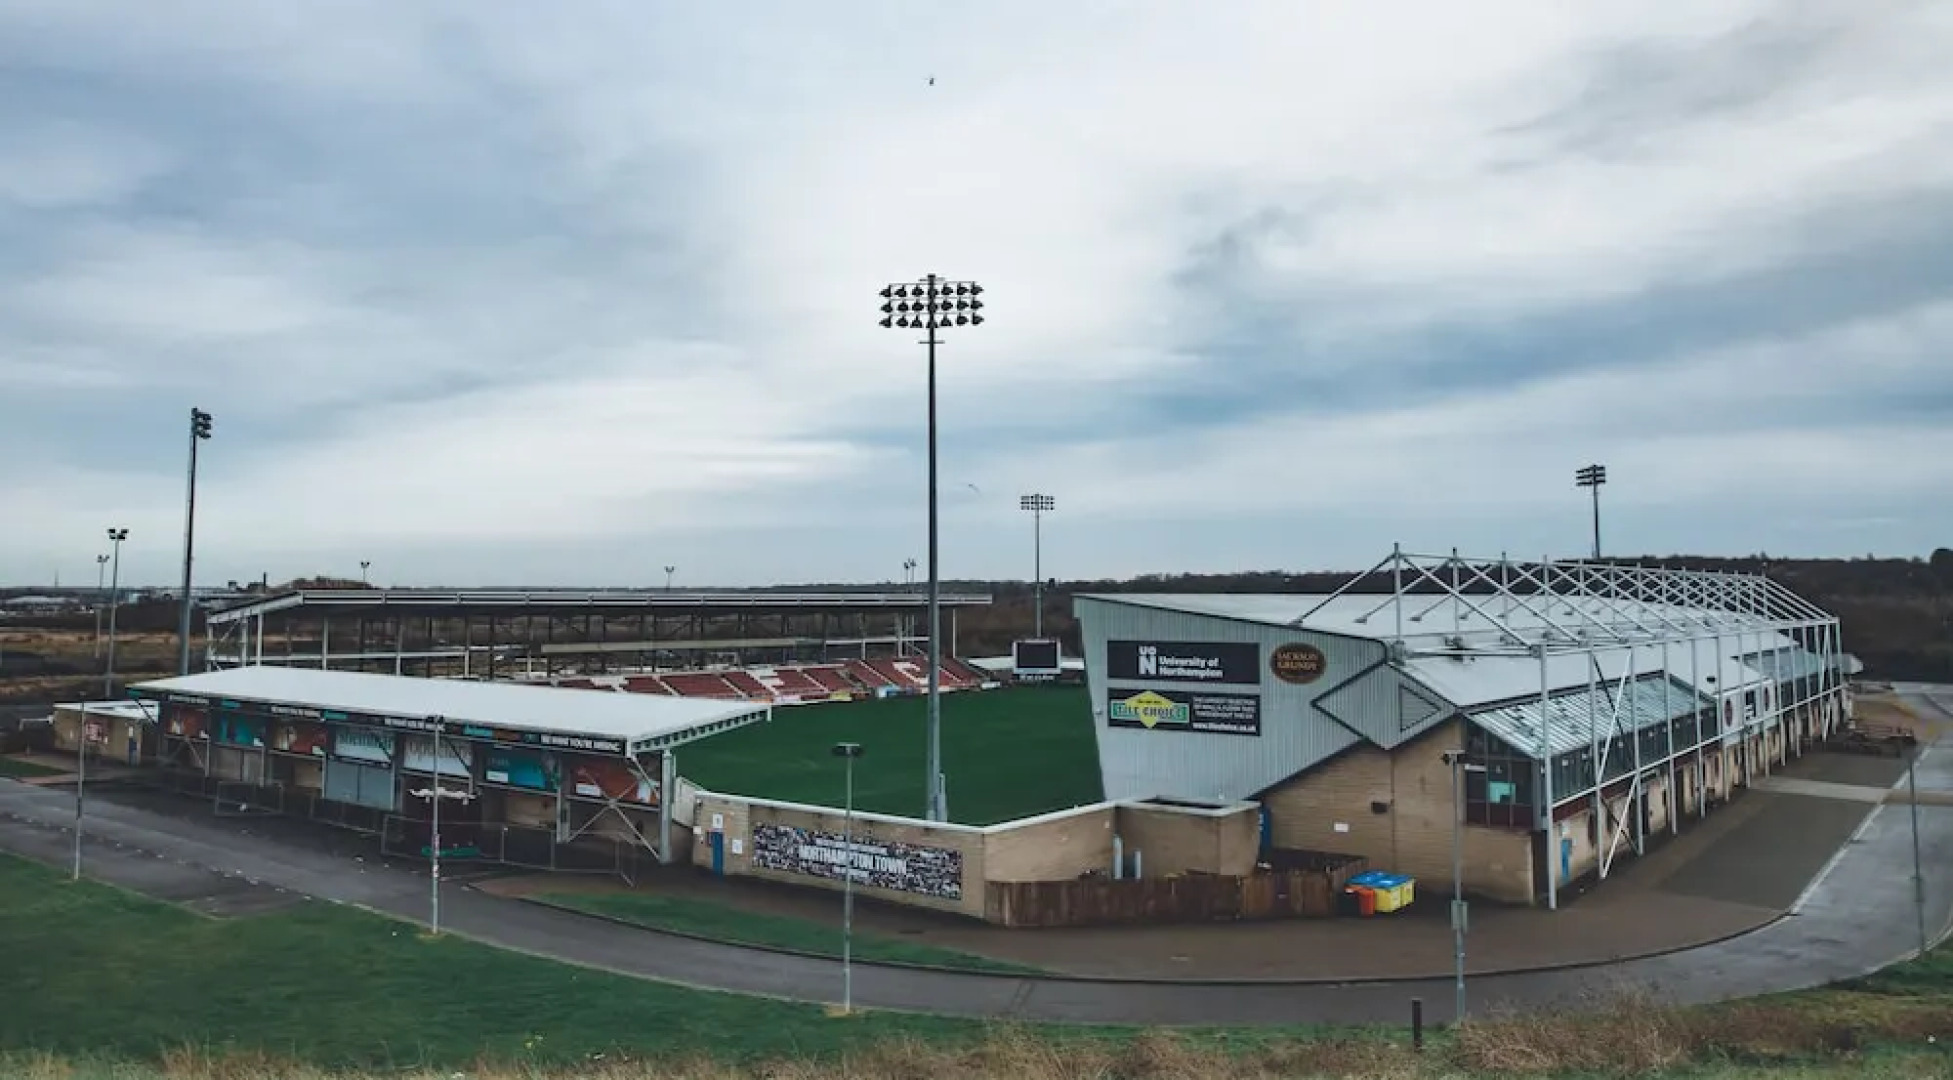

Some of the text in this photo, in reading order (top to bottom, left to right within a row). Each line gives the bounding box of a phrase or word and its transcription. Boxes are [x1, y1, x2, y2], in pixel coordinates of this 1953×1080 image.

[1160, 656, 1220, 668] University of
[1160, 668, 1224, 679] Northampton
[799, 846, 874, 869] NORTHAMPTON
[875, 855, 907, 875] TOWN
